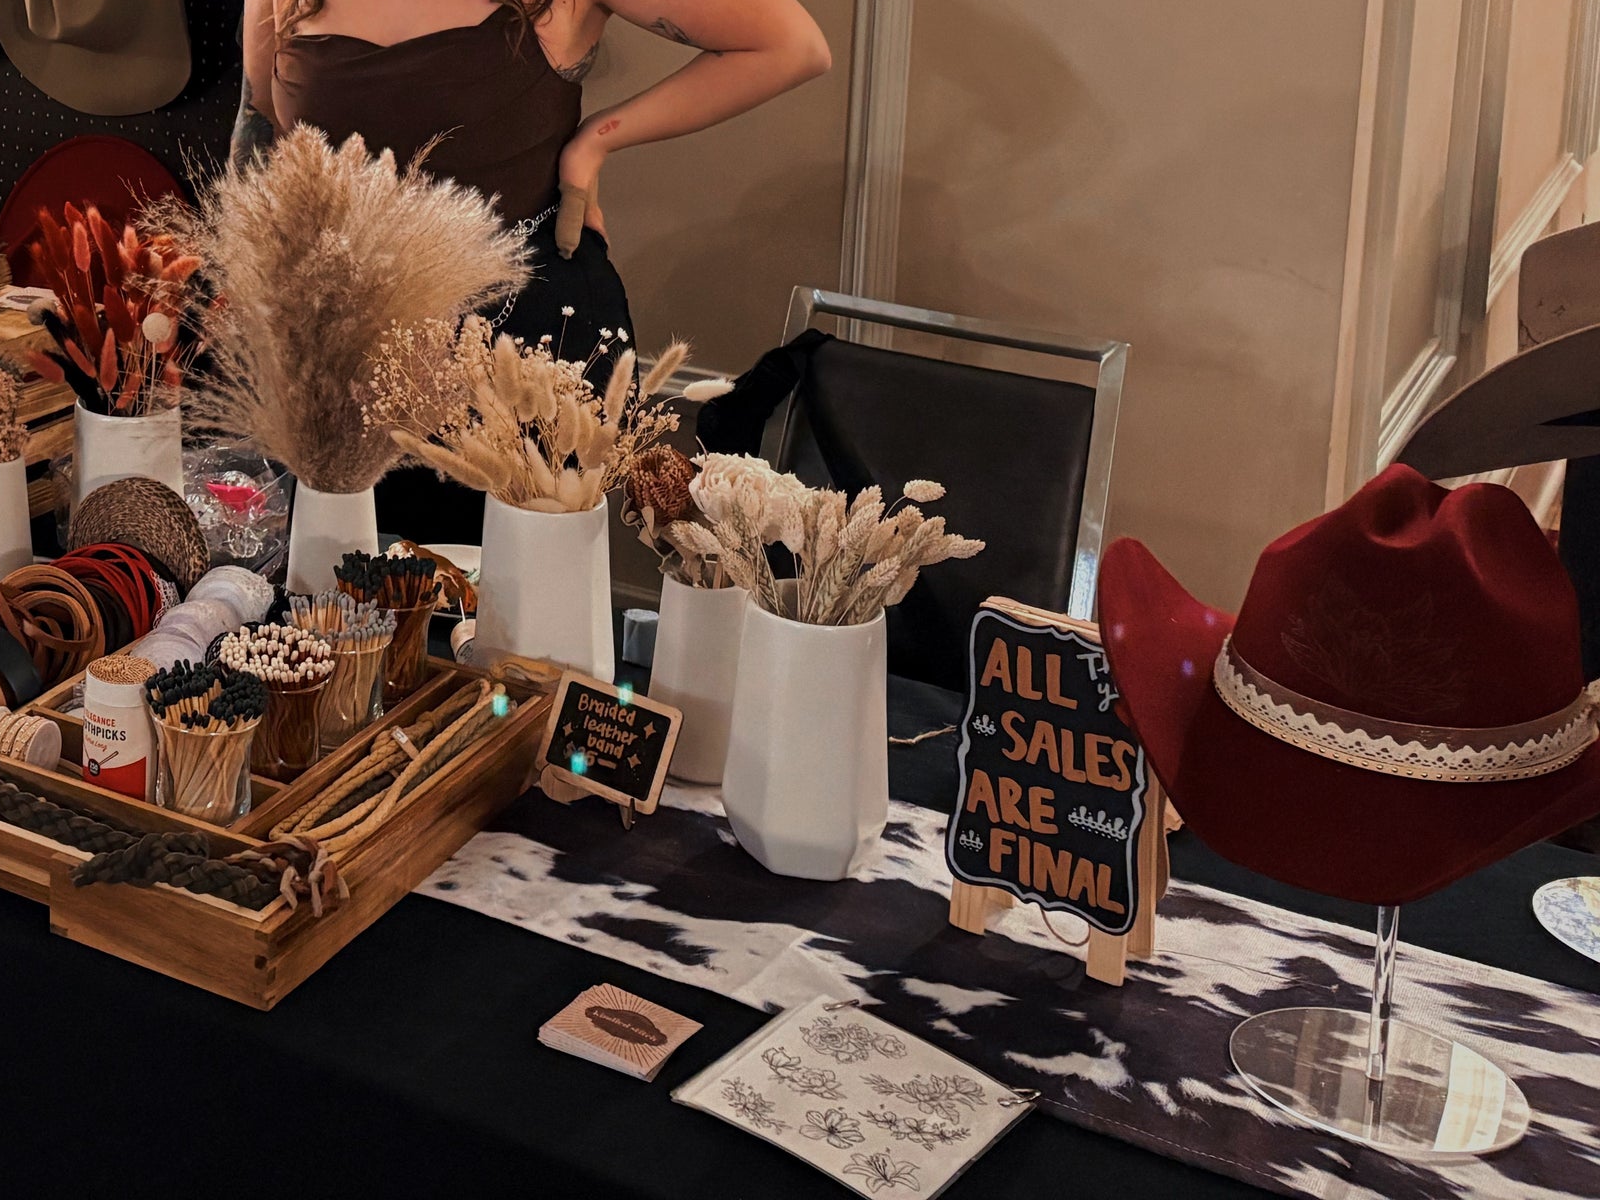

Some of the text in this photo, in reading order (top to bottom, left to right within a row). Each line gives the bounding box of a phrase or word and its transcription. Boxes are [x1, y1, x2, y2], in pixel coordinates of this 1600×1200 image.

[979, 636, 1079, 711] ALL
[577, 692, 637, 727] Braided
[583, 715, 639, 746] leather
[586, 732, 625, 760] band
[1000, 709, 1137, 791] SALES
[966, 768, 1059, 835] ARE
[988, 827, 1126, 915] FINAL
